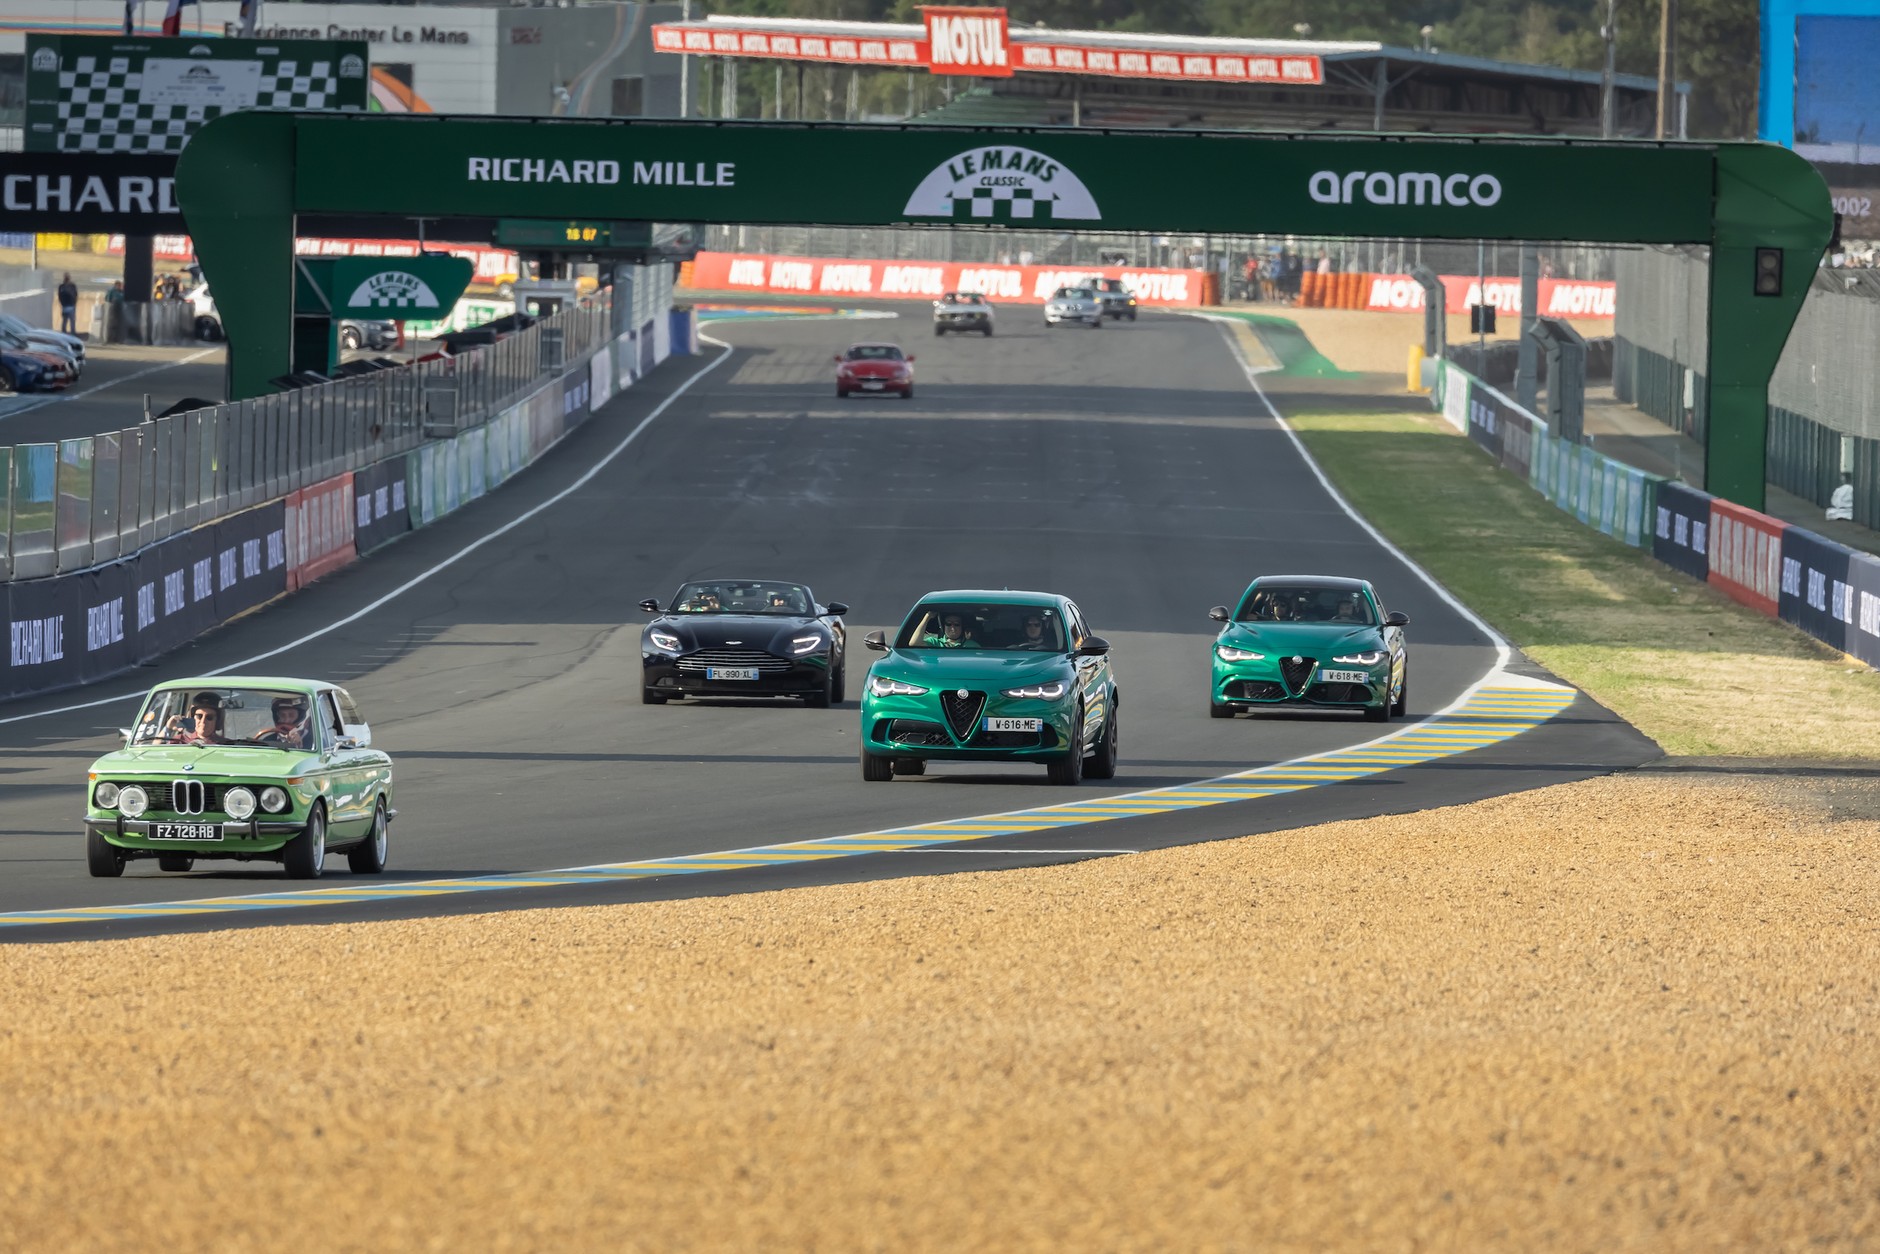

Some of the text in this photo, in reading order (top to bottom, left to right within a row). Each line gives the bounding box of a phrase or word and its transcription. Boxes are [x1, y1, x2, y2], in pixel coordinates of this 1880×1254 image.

[392, 26, 413, 43] Le
[421, 26, 469, 44] Mans
[931, 16, 1007, 66] MOTUL
[468, 157, 735, 186] RICHARD MILLE
[948, 150, 1060, 183] LE MANS
[980, 176, 1025, 187] CLASSIC
[1309, 171, 1502, 206] aramco
[769, 261, 813, 290] MOTUL
[820, 265, 872, 291] MOTUL
[880, 266, 944, 295] MOTUL
[957, 269, 1023, 298] MOTUL
[11, 614, 64, 666] RICHARD MILLE
